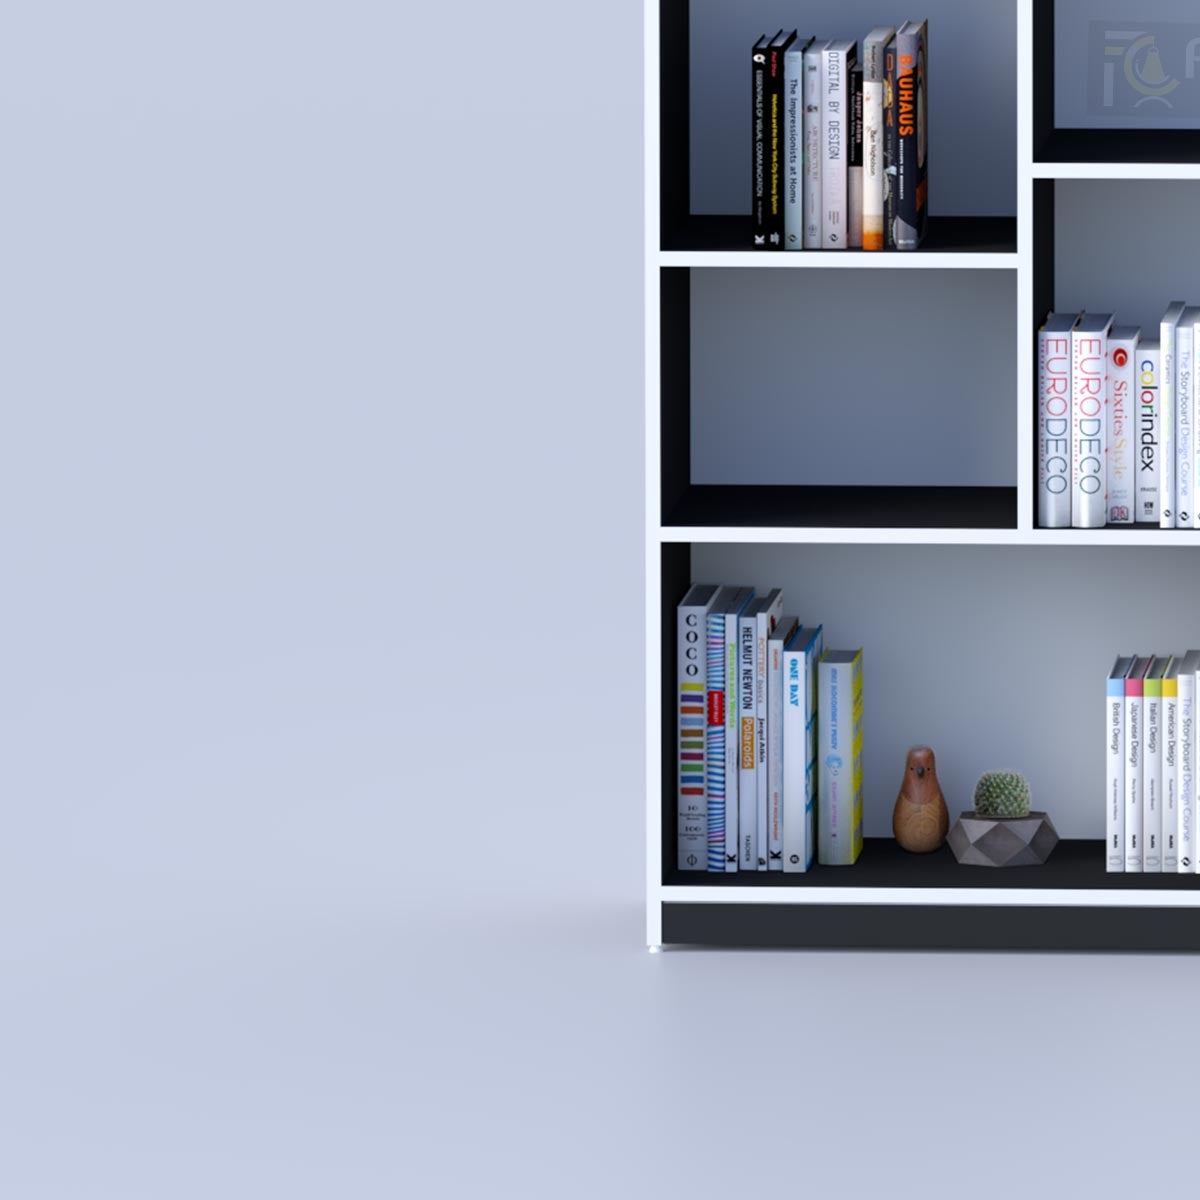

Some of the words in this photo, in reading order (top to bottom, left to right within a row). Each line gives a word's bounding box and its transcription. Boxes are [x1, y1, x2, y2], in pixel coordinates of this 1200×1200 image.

[828, 52, 840, 94] DIGITAL
[828, 101, 840, 114] BY
[899, 54, 913, 136] BAUHAUS
[828, 121, 840, 160] DESIGN
[1181, 351, 1190, 369] The
[1046, 339, 1067, 494] EURODECO
[1080, 339, 1101, 495] EURODECO
[1113, 380, 1128, 436] Sixties
[1141, 360, 1158, 472] colorindex
[1178, 371, 1190, 425] Storyboard
[1110, 439, 1128, 480] Style
[1178, 427, 1190, 460] Design
[1181, 461, 1189, 496] Course
[742, 626, 753, 665] HELMUT
[742, 669, 753, 709] NEWTON
[789, 658, 798, 680] ONE
[789, 684, 798, 706] DAY
[742, 717, 753, 768] Polaroids
[757, 717, 765, 739] Jacqui
